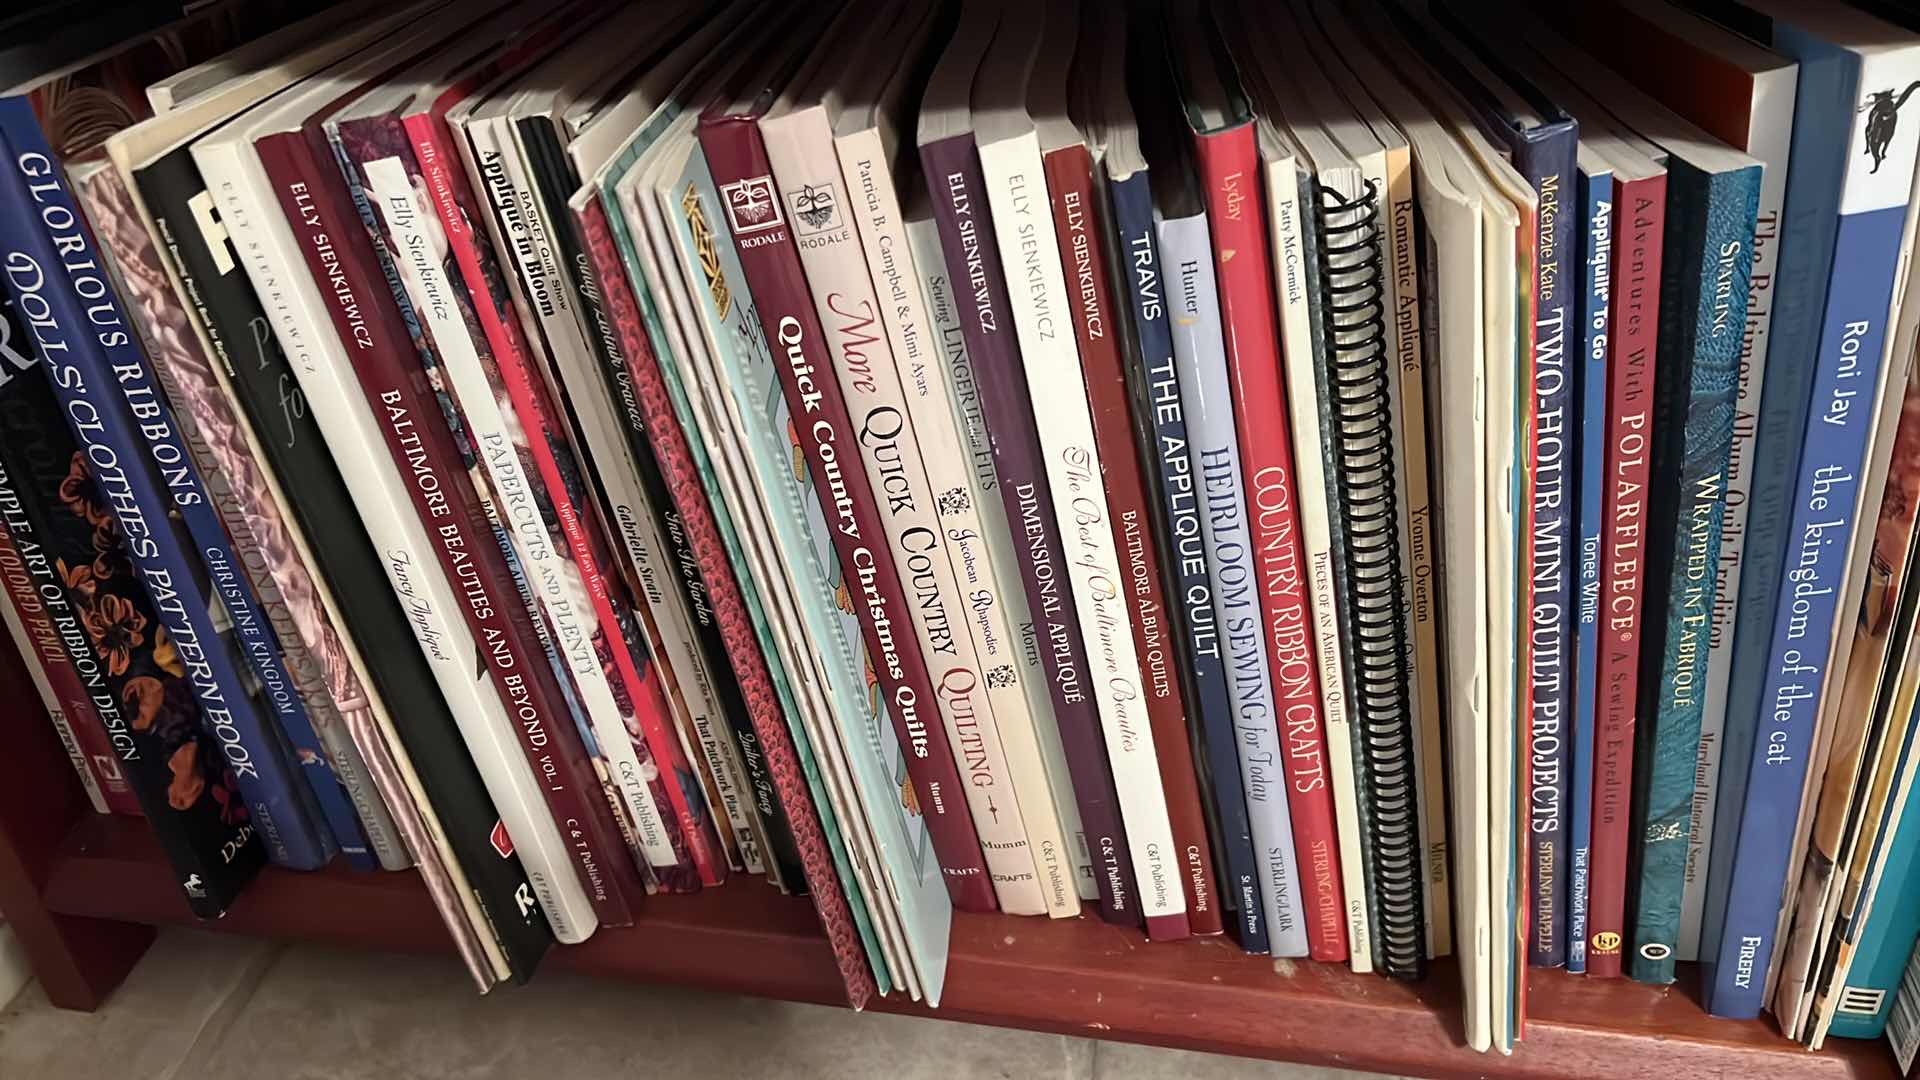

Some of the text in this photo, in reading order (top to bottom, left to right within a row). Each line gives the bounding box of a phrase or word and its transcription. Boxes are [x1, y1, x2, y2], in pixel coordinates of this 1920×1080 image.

[419, 141, 462, 233] Elly Sienkiewicz
[856, 159, 882, 212] Patricia
[872, 215, 886, 232] B.
[1220, 171, 1245, 221] Lyday
[289, 181, 374, 349] ELLY SIENKIEWICZ
[388, 195, 450, 321] Elly Sienkiewicz
[483, 149, 556, 317] Appliqué in Bloom
[519, 190, 568, 311] BASKET Quilt Show
[740, 231, 785, 249] RODALE
[800, 231, 849, 249] RODALE
[877, 235, 908, 302] Campbell
[947, 172, 999, 334] ELLY SIENKIEWICZ
[1008, 174, 1057, 342] ELLY SIENKIEWICZ
[1064, 191, 1105, 340] ELLY SIENKIEWICZ
[1130, 231, 1163, 321] TRAVIS
[1279, 199, 1302, 305] Patty McCormick
[1540, 174, 1559, 300] McKenzie Kate
[1627, 197, 1654, 336] Adventures
[1750, 209, 1777, 264] The
[17, 151, 130, 348] GLORIOUS
[111, 360, 202, 507] RIBBONS
[896, 305, 909, 319] &
[1180, 260, 1200, 314] Hunter
[1394, 199, 1419, 372] Romantic Appliqué
[1593, 306, 1608, 329] To
[1711, 240, 1741, 338] SPARLING
[900, 322, 922, 359] Mimi
[927, 275, 999, 492] Sewing LINGERIE FITS
[1592, 334, 1607, 359] Go
[1624, 349, 1645, 401] With
[1823, 319, 1870, 426] Roni Jay
[1725, 408, 1751, 483] Album
[4, 250, 89, 396] DOLLS'
[68, 398, 159, 559] CLOTHES
[142, 566, 229, 718] PATTERN
[208, 706, 259, 781] BOOK
[664, 510, 684, 546] Into
[777, 315, 824, 414] Quick
[811, 419, 862, 541] Country
[852, 546, 905, 680] Christmas
[894, 685, 931, 759] Quilts
[826, 292, 998, 789] More QUICK COUNTRY QUILTING
[1149, 357, 1220, 660] THE APPLIQUE QUILT
[17, 538, 53, 577] ART
[39, 582, 70, 612] OF
[380, 388, 558, 783] BALTIMORE BEAUTIES AND BEYOND, VOL.
[385, 548, 417, 599] Fancy
[481, 430, 598, 678] PAPERCUTS AND PLENTY
[616, 504, 663, 604] Gabrielle Swain
[676, 547, 697, 578] The
[947, 527, 1000, 657] Jacobean Rhapsodies
[1013, 482, 1086, 705] DIMENSIONAL APPLIQUÉ
[1061, 445, 1141, 753] The Best of Baltimore Beauties
[1411, 505, 1432, 623] Yvonne Overton
[1531, 307, 1564, 833] TWO-HOUR MINI QUILT PROJECTS
[1581, 533, 1600, 623] Tonee White
[1671, 472, 1721, 708] WRAPPED IN FABRIQUÉ
[1705, 548, 1740, 649] Tradition
[205, 546, 296, 714] CHRISTINE KINGDOM
[686, 579, 714, 626] Garden
[1019, 622, 1040, 667] Morris
[1120, 509, 1171, 698] BALTIMORE ALBUM QUILTS
[1200, 446, 1274, 805] HEIRLOOM SEWING for Today
[1253, 466, 1325, 793] COUNTRY RIBBON CRAFTS
[1313, 551, 1342, 723] PIECES OF AN AMERICAN QUILT
[1766, 463, 1853, 766] the kingdom of the cat
[54, 614, 105, 688] RIBBON
[92, 692, 140, 762] DESIGN
[695, 714, 712, 739] That
[703, 740, 732, 793] Patchwork
[1601, 652, 1627, 824] A Sewing Expedition
[618, 760, 641, 789] C&T
[723, 794, 741, 820] Place
[736, 729, 775, 817] Quilter's Fancy
[928, 781, 947, 814] Mumm
[629, 791, 661, 848] Publishing
[981, 838, 1026, 850] Mumm
[943, 866, 981, 876] CRAFTS
[992, 871, 1033, 882] CRAFTS
[1145, 842, 1170, 909] C&T Publishing
[1186, 845, 1210, 912] C&T Publishing
[1735, 935, 1762, 988] FIREFLY
